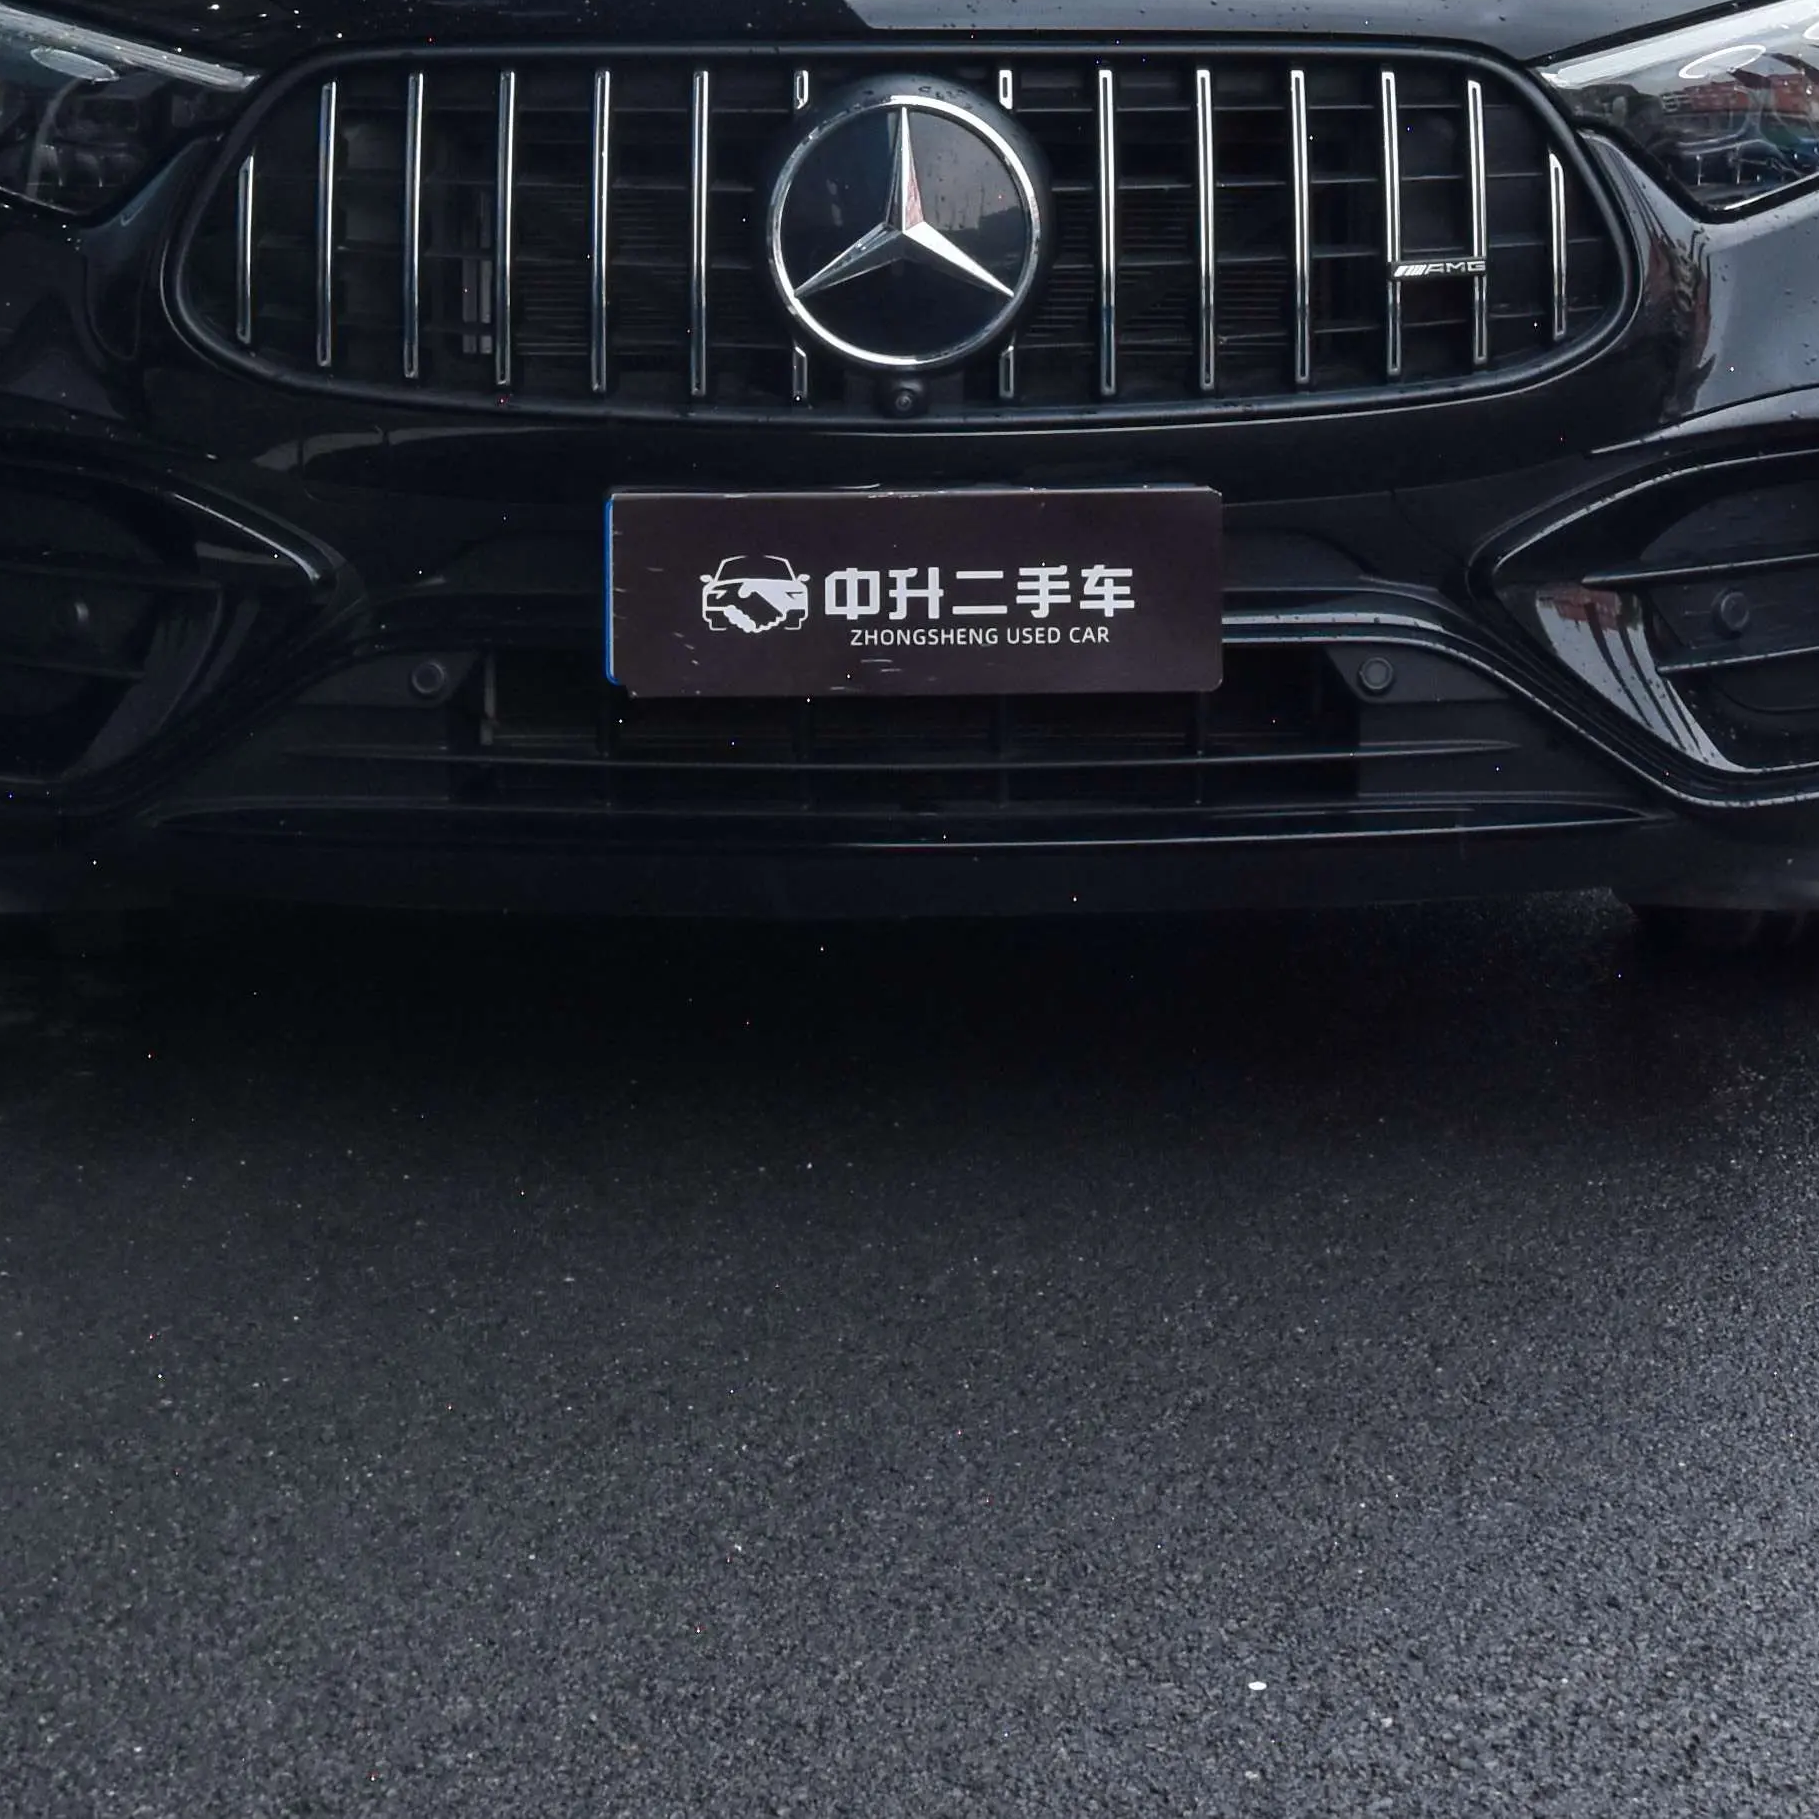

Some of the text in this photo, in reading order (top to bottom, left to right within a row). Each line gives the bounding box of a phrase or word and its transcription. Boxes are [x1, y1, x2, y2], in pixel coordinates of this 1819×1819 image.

[1423, 260, 1486, 275] AMG
[824, 565, 1135, 620] 中升二手车
[850, 625, 1110, 646] ZHONGSHENG USED CAR
